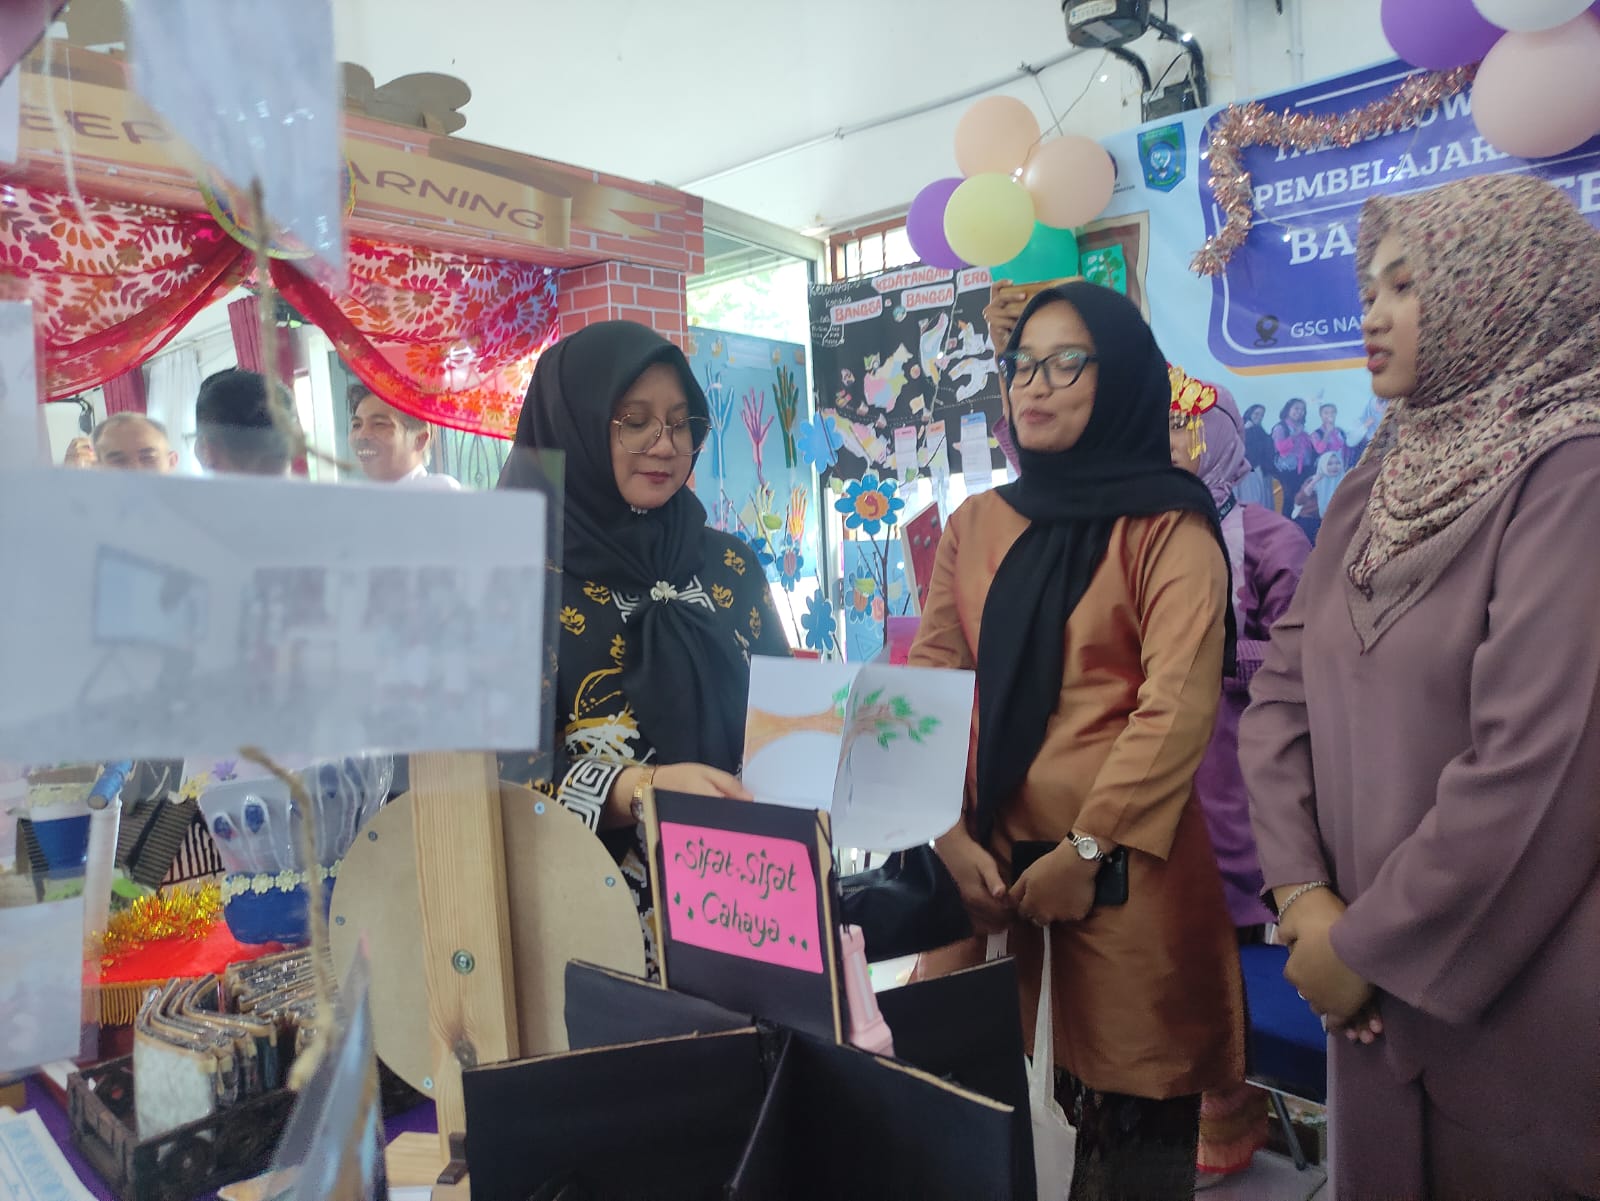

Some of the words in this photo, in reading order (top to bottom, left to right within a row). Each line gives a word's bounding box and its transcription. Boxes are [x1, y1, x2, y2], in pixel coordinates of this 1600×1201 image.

[1252, 135, 1510, 211] PEMBELAJAR
[834, 299, 882, 322] BANGSA
[905, 287, 953, 308] BANGSA
[1290, 320, 1329, 338] GSG
[701, 891, 780, 948] Cahaya
